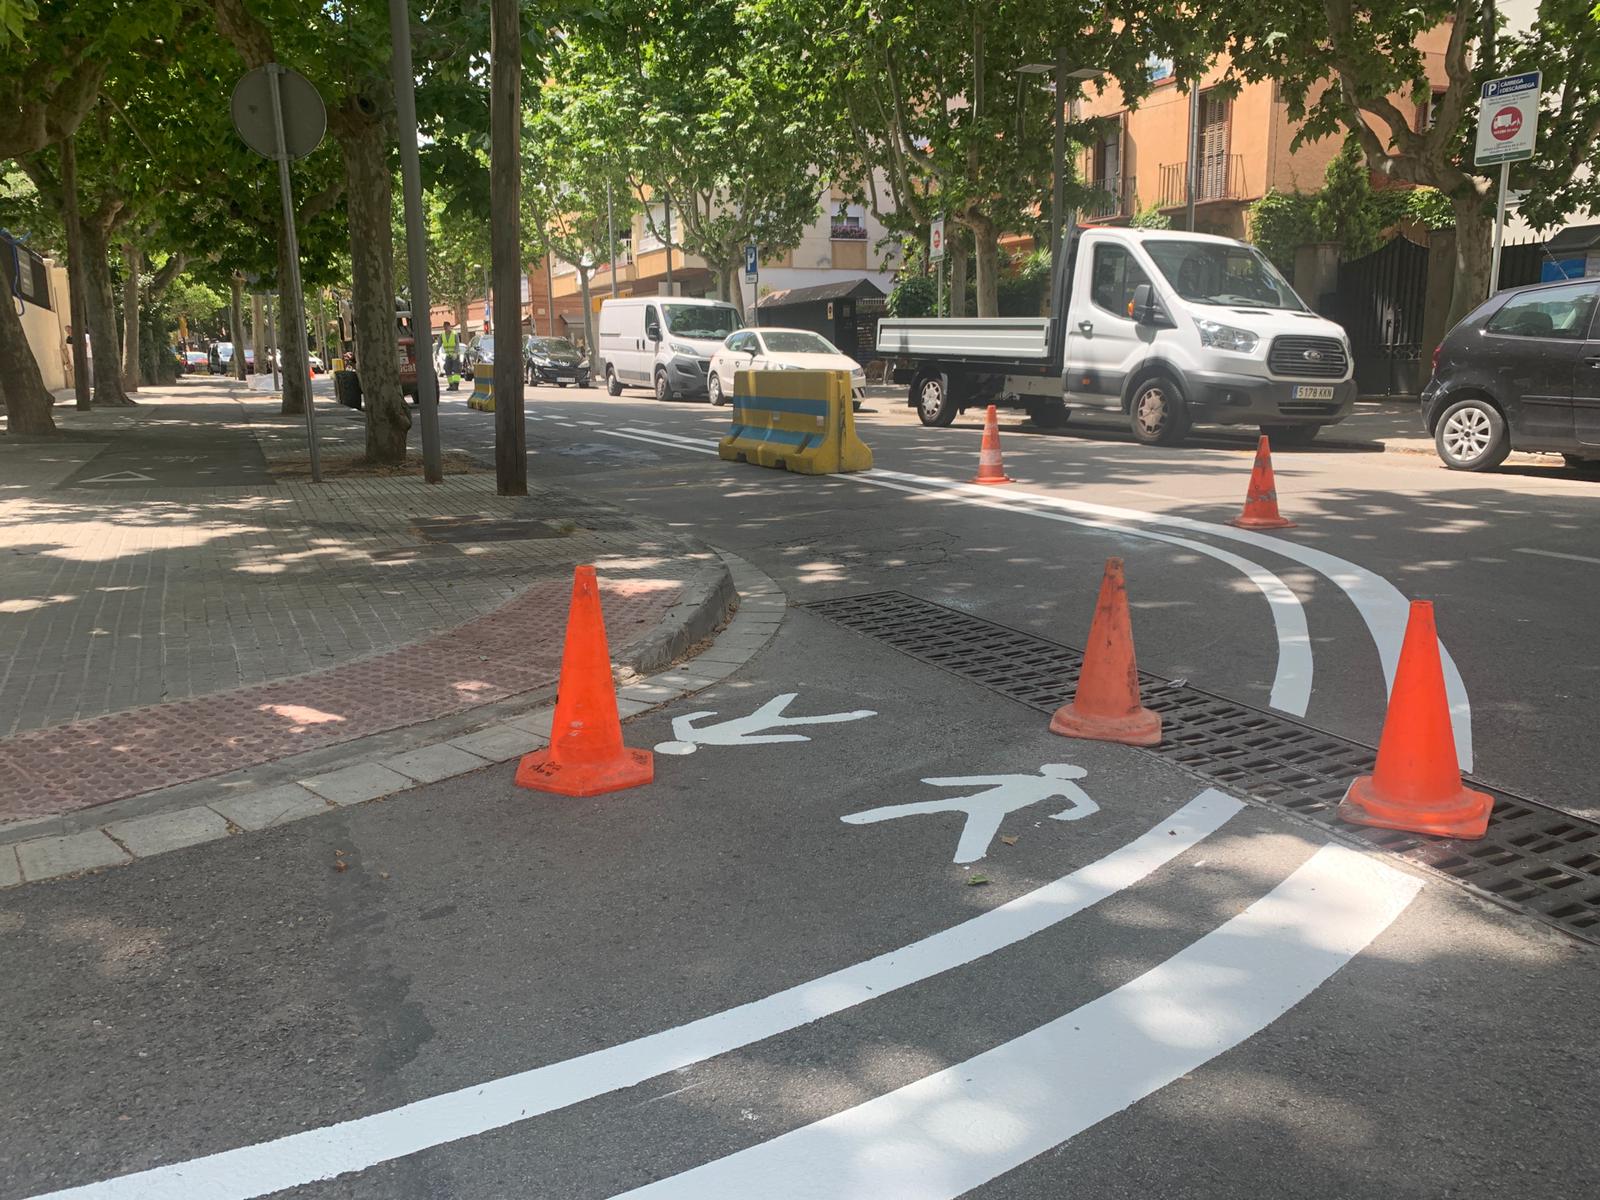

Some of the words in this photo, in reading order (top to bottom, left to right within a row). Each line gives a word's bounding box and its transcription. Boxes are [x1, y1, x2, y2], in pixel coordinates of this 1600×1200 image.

[1488, 83, 1498, 96] P
[746, 248, 755, 271] P
[1298, 387, 1318, 398] 5178
